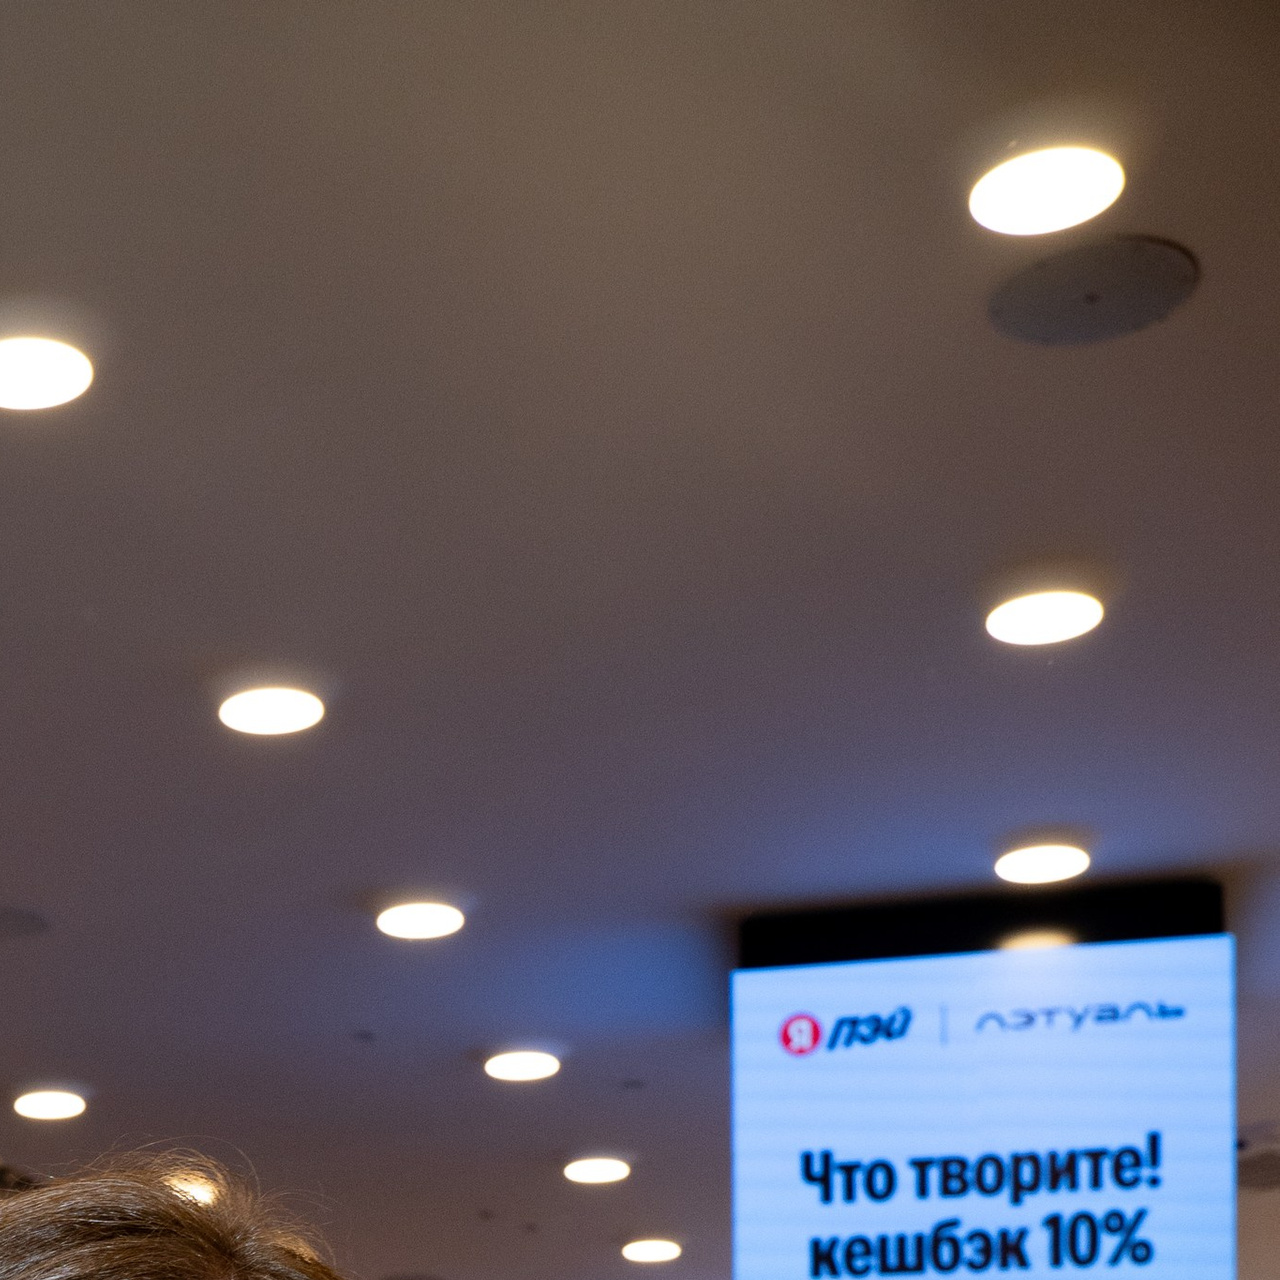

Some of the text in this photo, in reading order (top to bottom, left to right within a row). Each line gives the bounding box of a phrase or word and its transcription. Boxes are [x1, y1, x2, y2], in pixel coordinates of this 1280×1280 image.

[801, 1131, 1161, 1206] Что творите!
[809, 1207, 1154, 1278] кешбэк 10%
